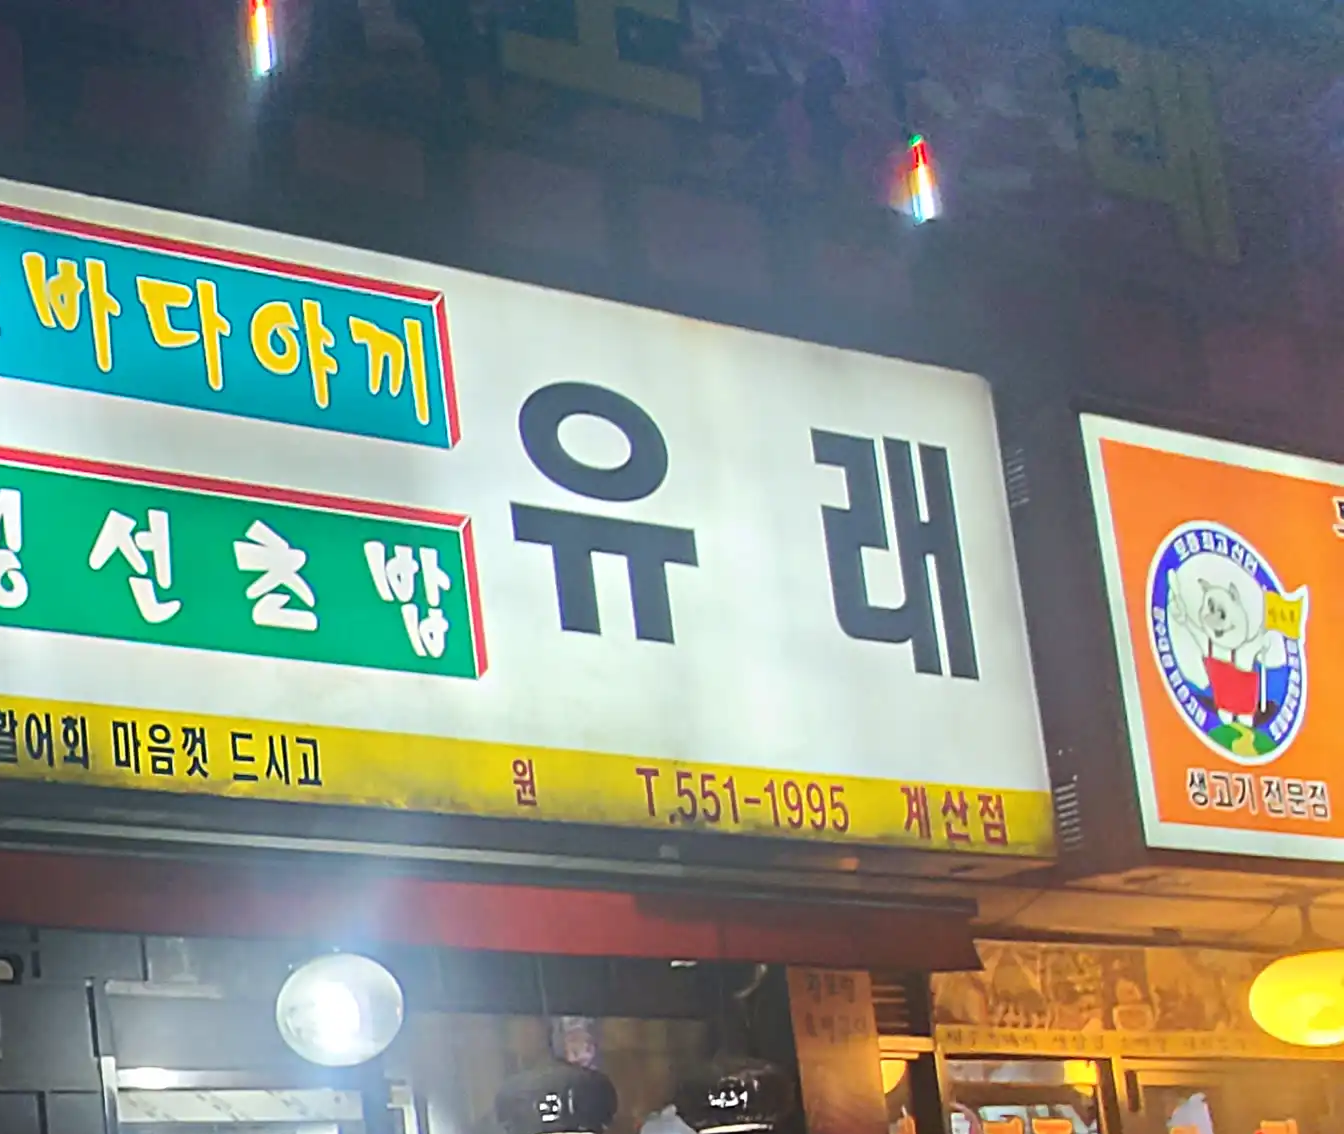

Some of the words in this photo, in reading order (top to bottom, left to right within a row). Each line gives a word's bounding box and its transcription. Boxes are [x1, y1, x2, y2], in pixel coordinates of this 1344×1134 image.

[509, 381, 980, 682] 유래
[111, 724, 210, 779] 마음껏
[229, 731, 324, 787] 드시고
[511, 759, 538, 810] 원
[634, 764, 852, 836] T.551-1995
[900, 783, 1010, 848] 계산점
[1187, 766, 1256, 816] 생고기
[1261, 776, 1332, 821] 전문점
